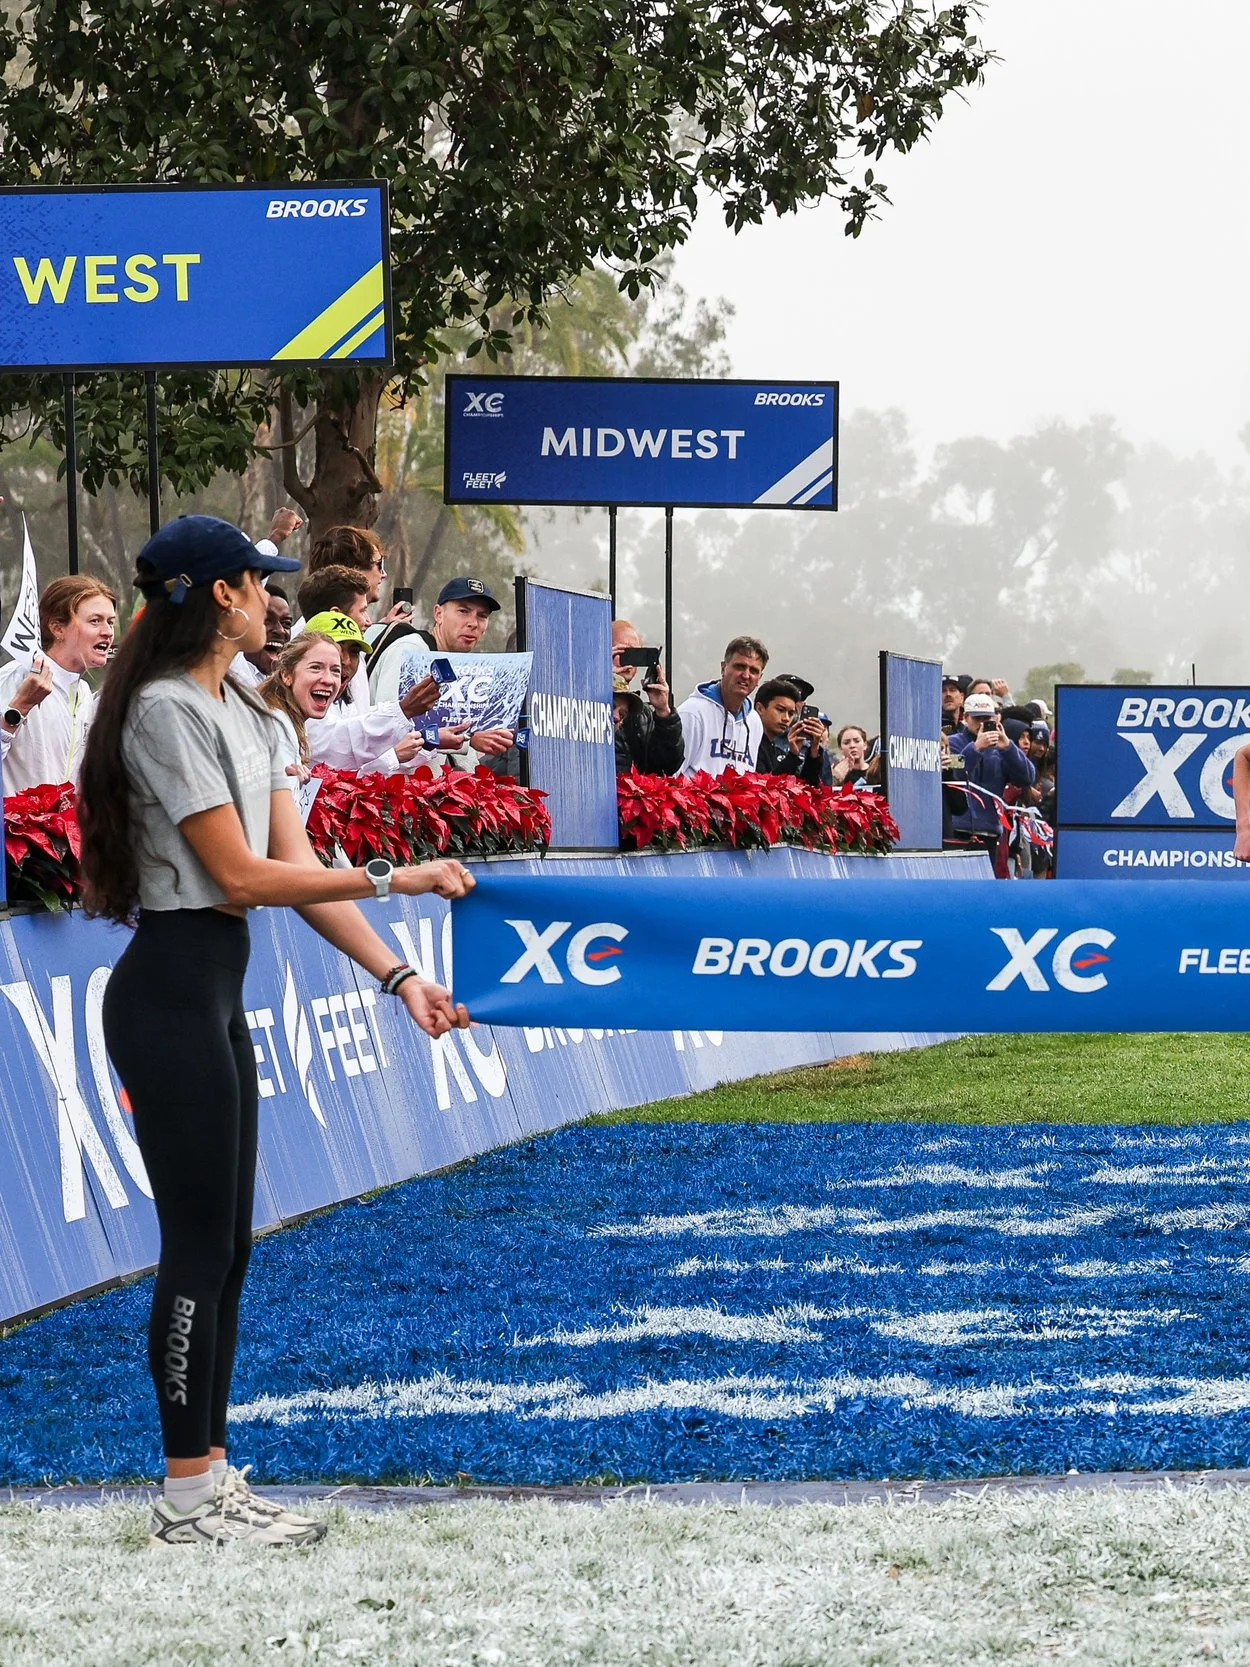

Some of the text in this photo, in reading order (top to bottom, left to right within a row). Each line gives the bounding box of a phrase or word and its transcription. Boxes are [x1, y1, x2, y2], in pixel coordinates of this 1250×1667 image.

[265, 198, 368, 218] BROOKS
[13, 254, 200, 304] WEST
[463, 392, 505, 413] XC
[754, 392, 825, 406] BROOKS
[540, 427, 745, 459] MIDWEST
[463, 472, 496, 481] FLEET
[465, 480, 494, 489] FEET
[331, 617, 357, 633] XC
[455, 665, 495, 676] ROOKS
[440, 676, 495, 703] XC
[531, 691, 612, 746] CHAMPIONSHIPS
[889, 734, 941, 772] CHAMPIONSHIPS
[500, 919, 629, 985] XC
[692, 937, 923, 978] BROOKS
[985, 927, 1117, 993] XC
[311, 988, 391, 1082] FEET
[164, 1295, 196, 1406] BROOKS
